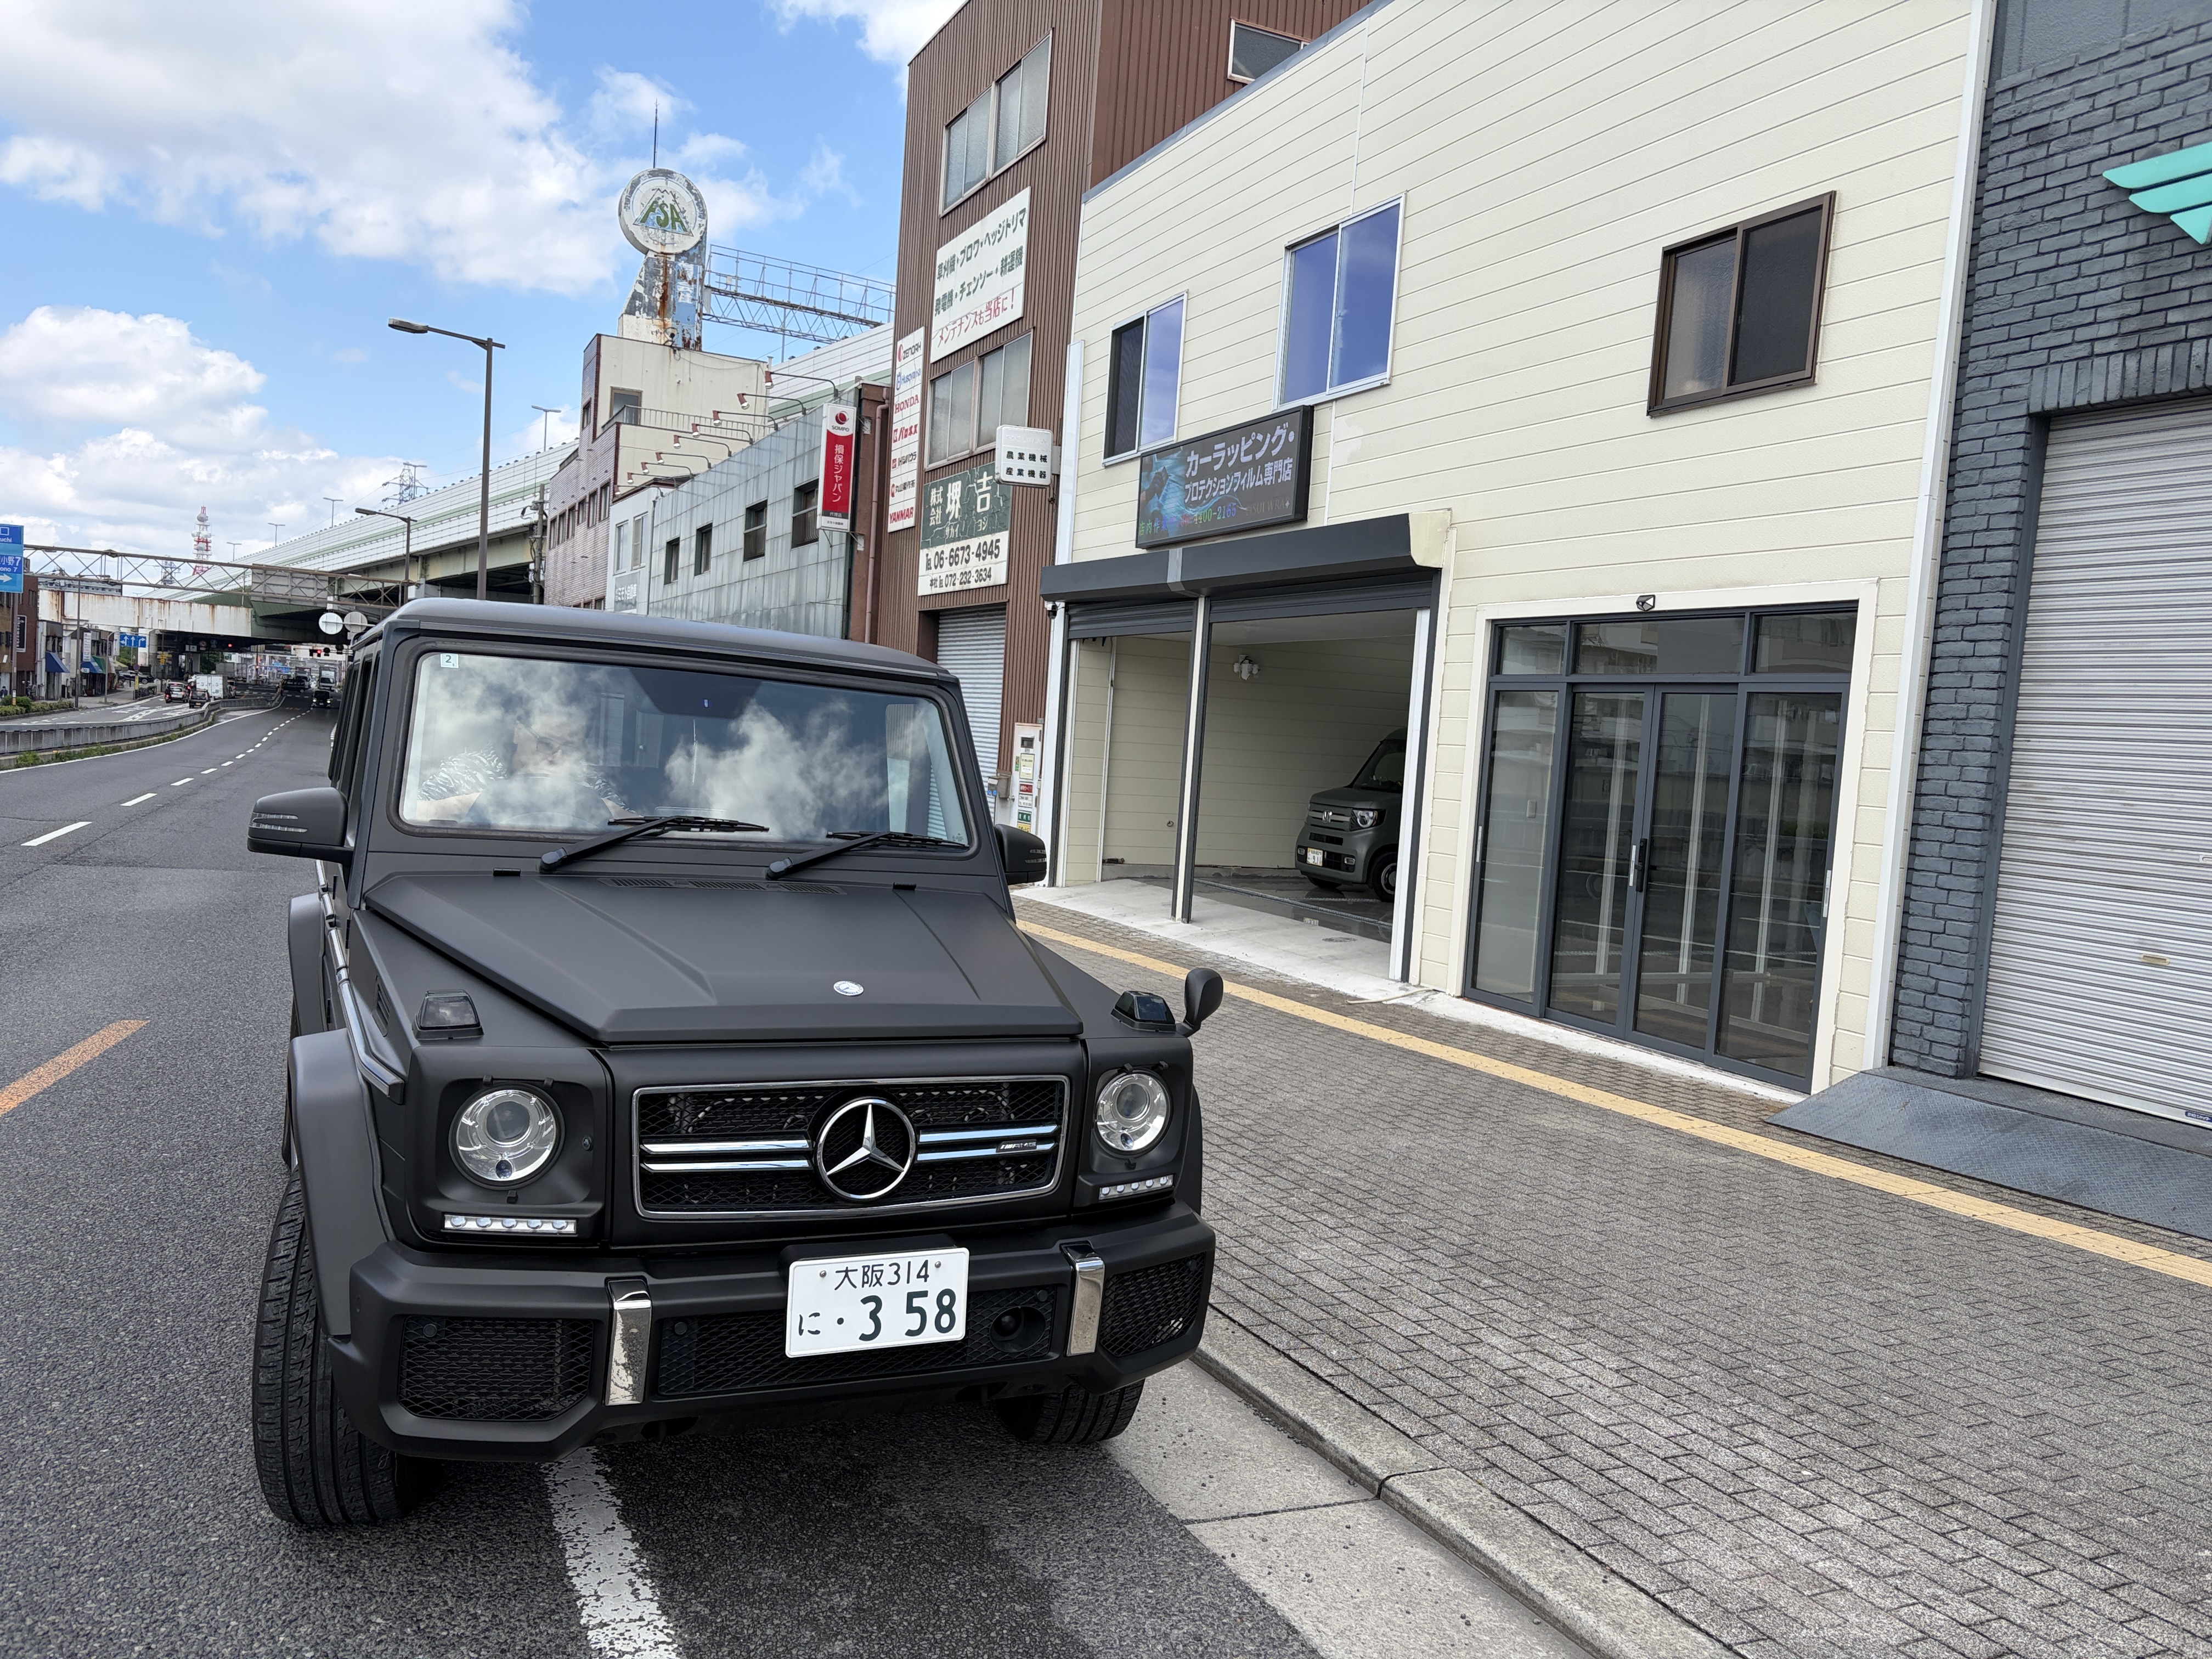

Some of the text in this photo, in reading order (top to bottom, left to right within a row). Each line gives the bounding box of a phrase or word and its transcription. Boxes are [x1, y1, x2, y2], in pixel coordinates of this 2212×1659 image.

[640, 201, 687, 232] FSA
[894, 394, 919, 414] HONDA
[1006, 451, 1048, 463] 農業機械
[832, 444, 844, 503] 損保ジャパン
[1006, 467, 1047, 479] 産業機器
[1184, 456, 1293, 504] プロテクションフィルム専門店
[890, 507, 914, 524] YANMAR
[0, 556, 21, 566] 小野7
